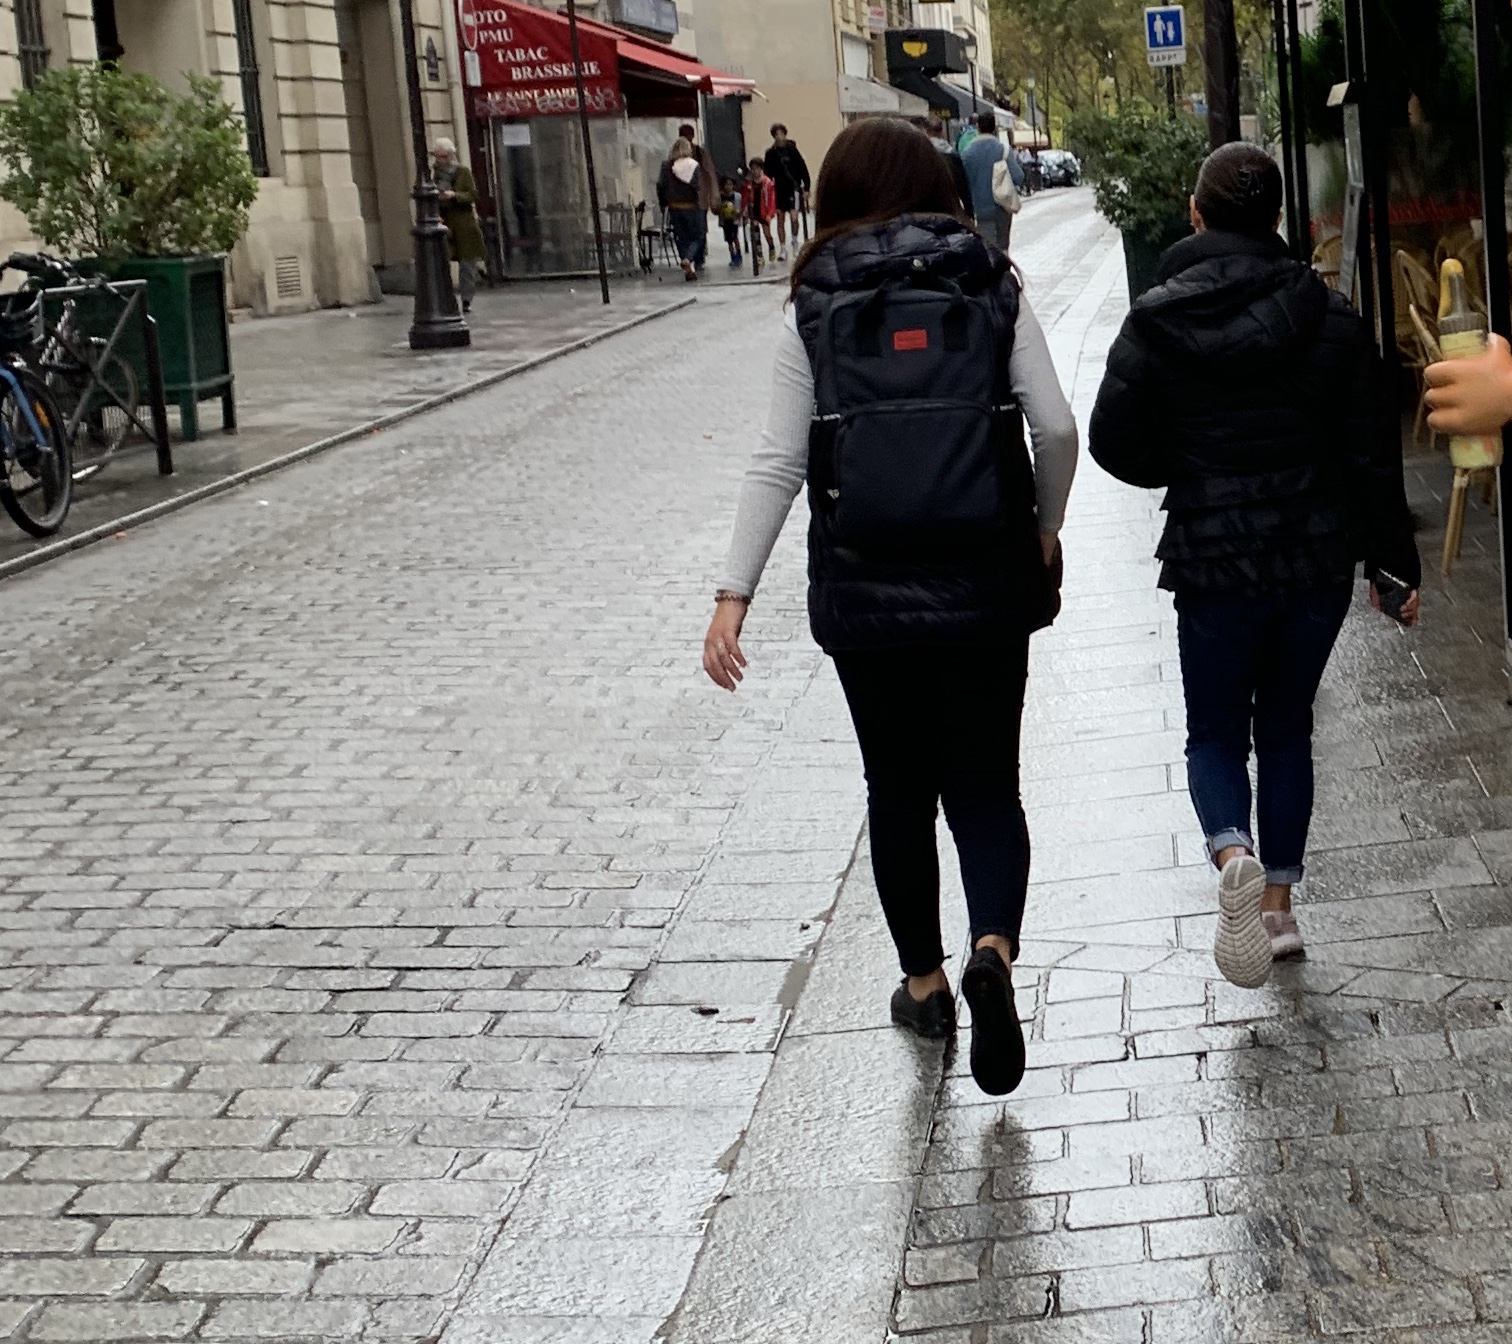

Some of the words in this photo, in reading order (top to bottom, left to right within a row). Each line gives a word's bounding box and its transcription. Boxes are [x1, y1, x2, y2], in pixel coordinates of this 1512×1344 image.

[474, 9, 507, 25] OTO
[479, 27, 514, 44] PMU
[493, 46, 548, 64] TABAC
